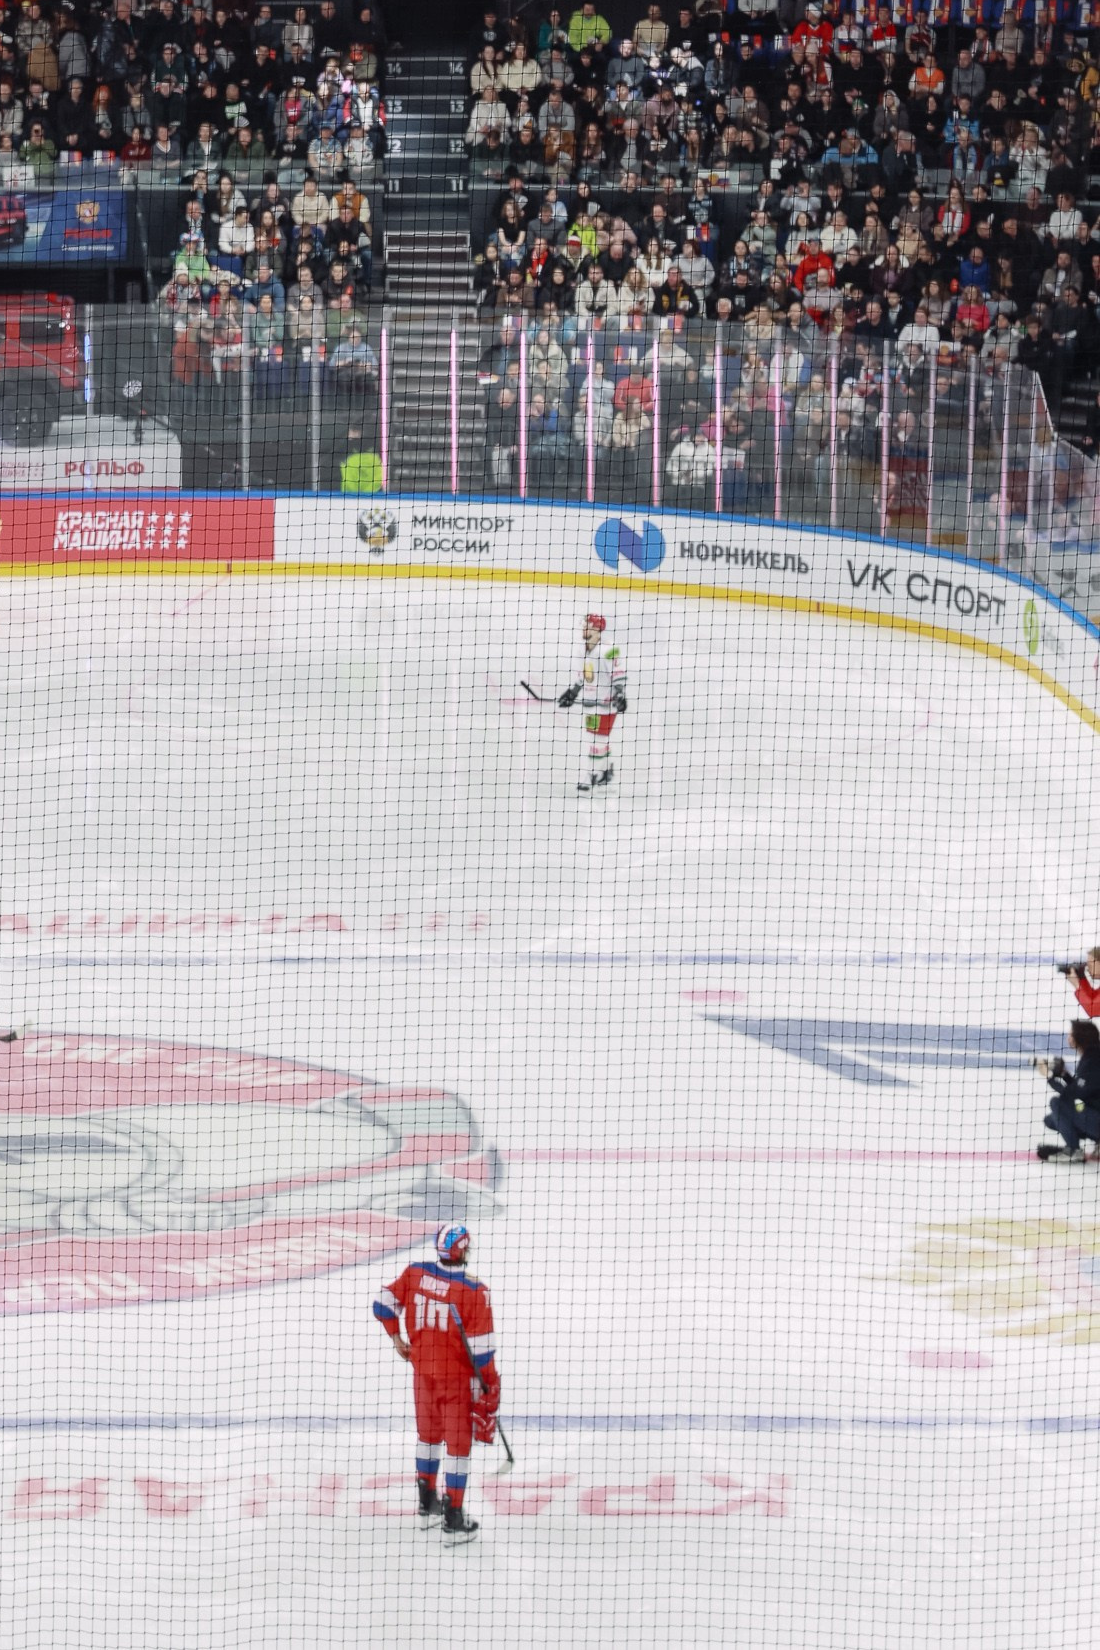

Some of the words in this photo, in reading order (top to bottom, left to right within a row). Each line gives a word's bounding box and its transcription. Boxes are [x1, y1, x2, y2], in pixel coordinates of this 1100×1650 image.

[449, 61, 464, 75] 14
[387, 139, 402, 153] 12
[388, 179, 400, 192] 11
[451, 179, 463, 192] 11
[64, 461, 146, 478] РОЛЬФ
[55, 510, 145, 530] КРАСНАЯ
[411, 514, 516, 534] МИНСПОРТ
[53, 529, 141, 551] МАШИНА
[412, 536, 491, 555] РОССИИ
[679, 540, 810, 575] НОРНИКЕЛЬ
[847, 559, 897, 595] VK
[906, 572, 1007, 626] СПОРТ
[25, 1033, 157, 1065] ONE
